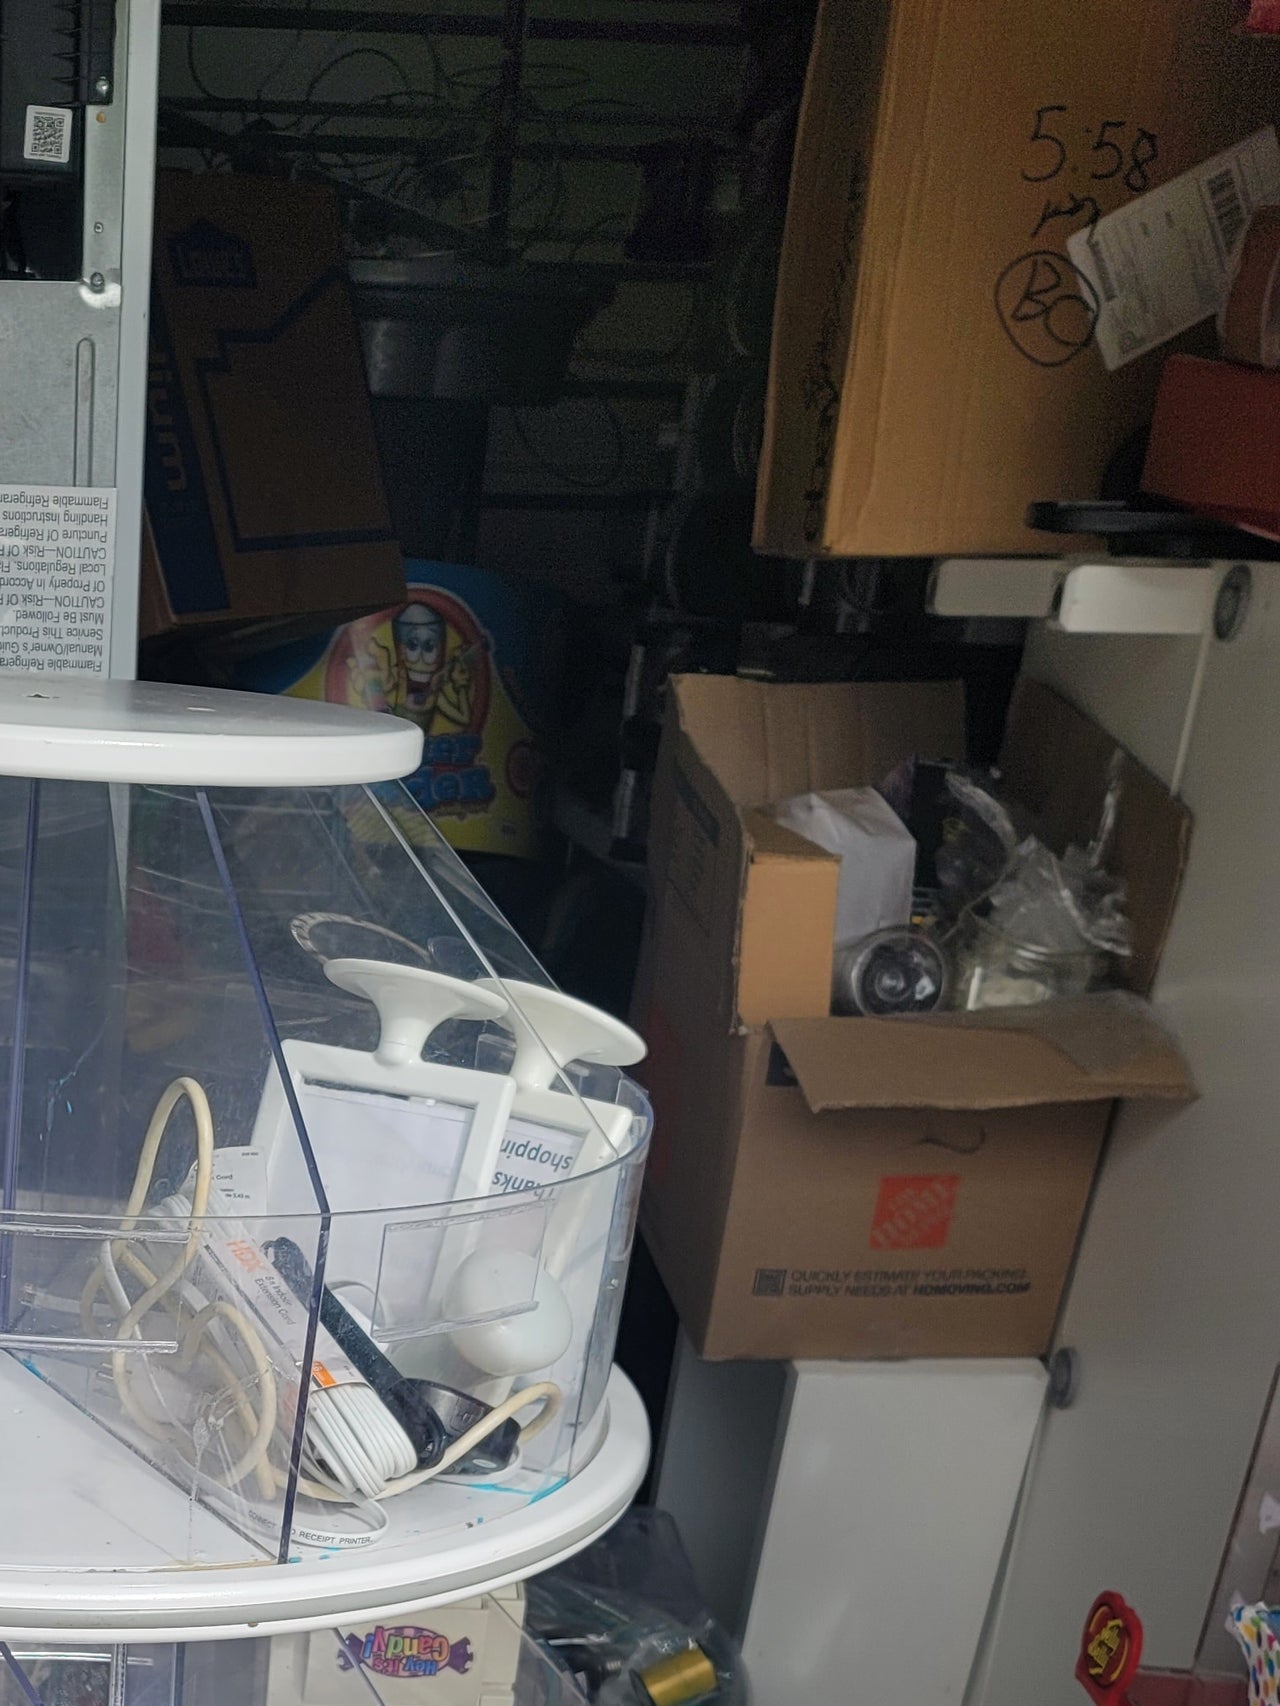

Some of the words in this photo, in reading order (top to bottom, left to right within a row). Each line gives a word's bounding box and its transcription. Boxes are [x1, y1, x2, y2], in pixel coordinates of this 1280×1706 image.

[53, 496, 108, 510] Flammable
[3, 511, 60, 525] Instructions
[64, 510, 108, 526] Handling
[47, 528, 59, 541] Of
[63, 529, 107, 543] Puncture
[7, 544, 20, 557] Of
[14, 558, 76, 574] Regulations.
[80, 563, 106, 575] Local
[37, 578, 45, 590] In
[49, 576, 90, 592] Properly
[94, 580, 105, 592] Of
[6, 593, 18, 606] Of
[14, 610, 60, 623] Followed.
[64, 611, 76, 623] Be
[80, 612, 104, 624] Must
[43, 626, 63, 639] This
[67, 627, 103, 640] Service
[23, 642, 102, 656] Manual/Owner's
[48, 659, 102, 672] Flammable
[500, 1138, 574, 1173] shoppin
[299, 1530, 336, 1544] RECEIPT
